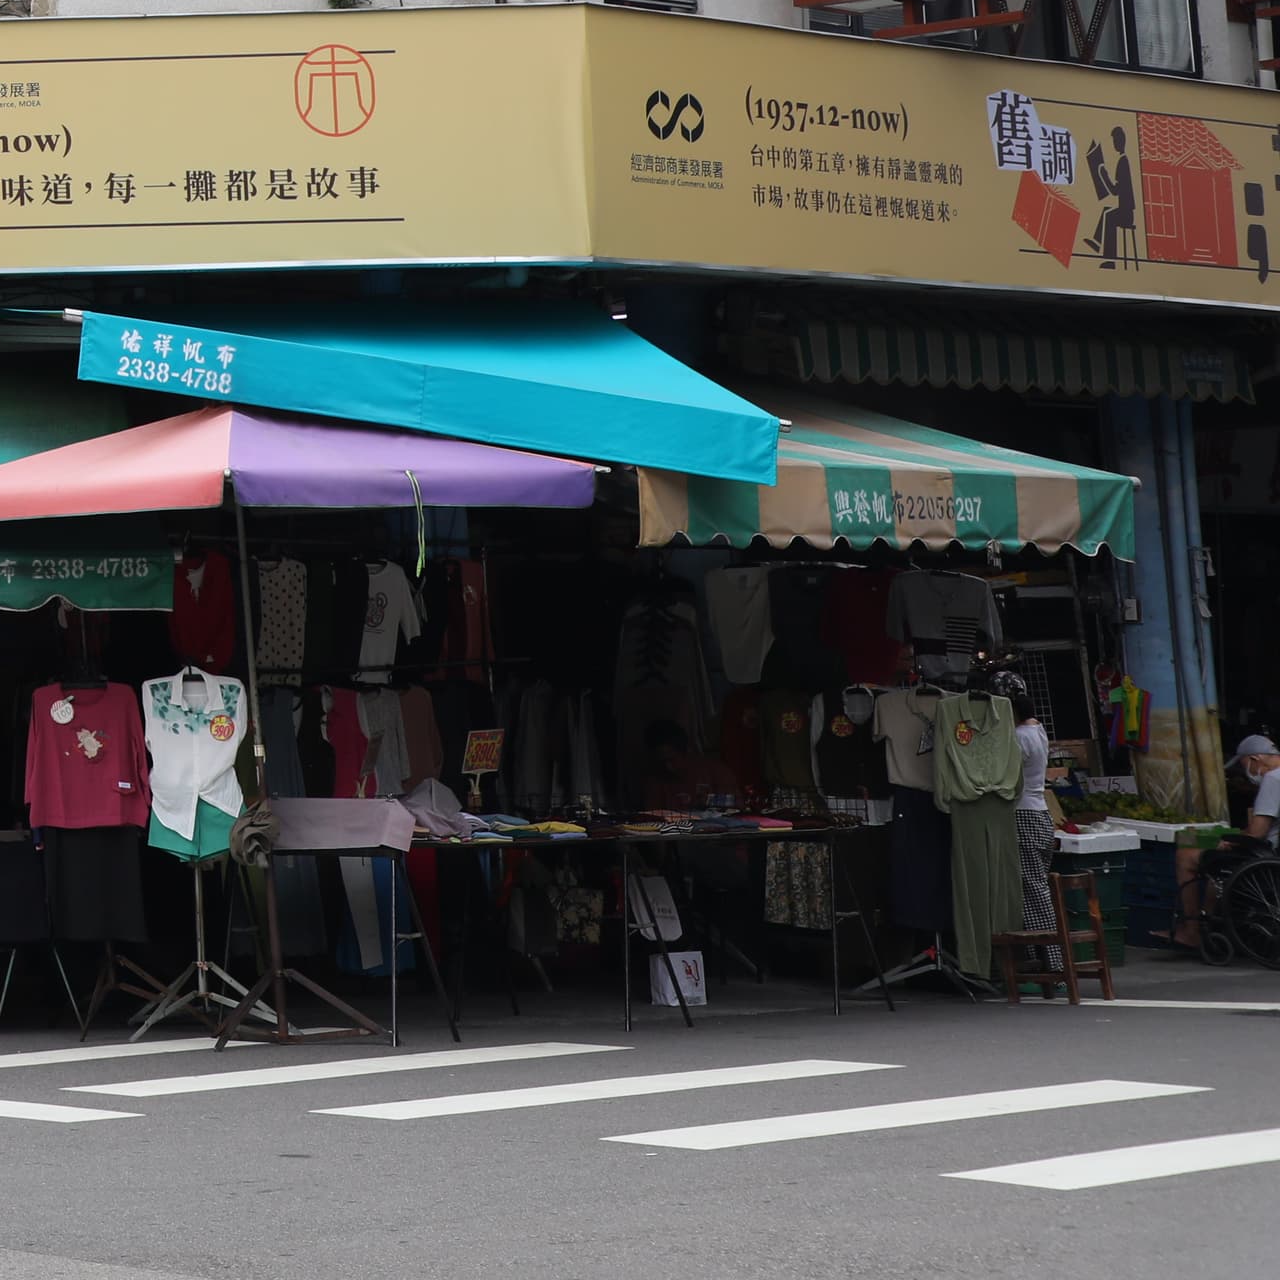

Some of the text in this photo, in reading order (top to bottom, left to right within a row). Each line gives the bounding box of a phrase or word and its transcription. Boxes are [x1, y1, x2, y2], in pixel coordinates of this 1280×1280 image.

[745, 85, 909, 142] (1937.12-now)
[988, 91, 1074, 185] 舊調
[117, 356, 232, 395] 2338-4788
[31, 557, 149, 580] 2338-4788
